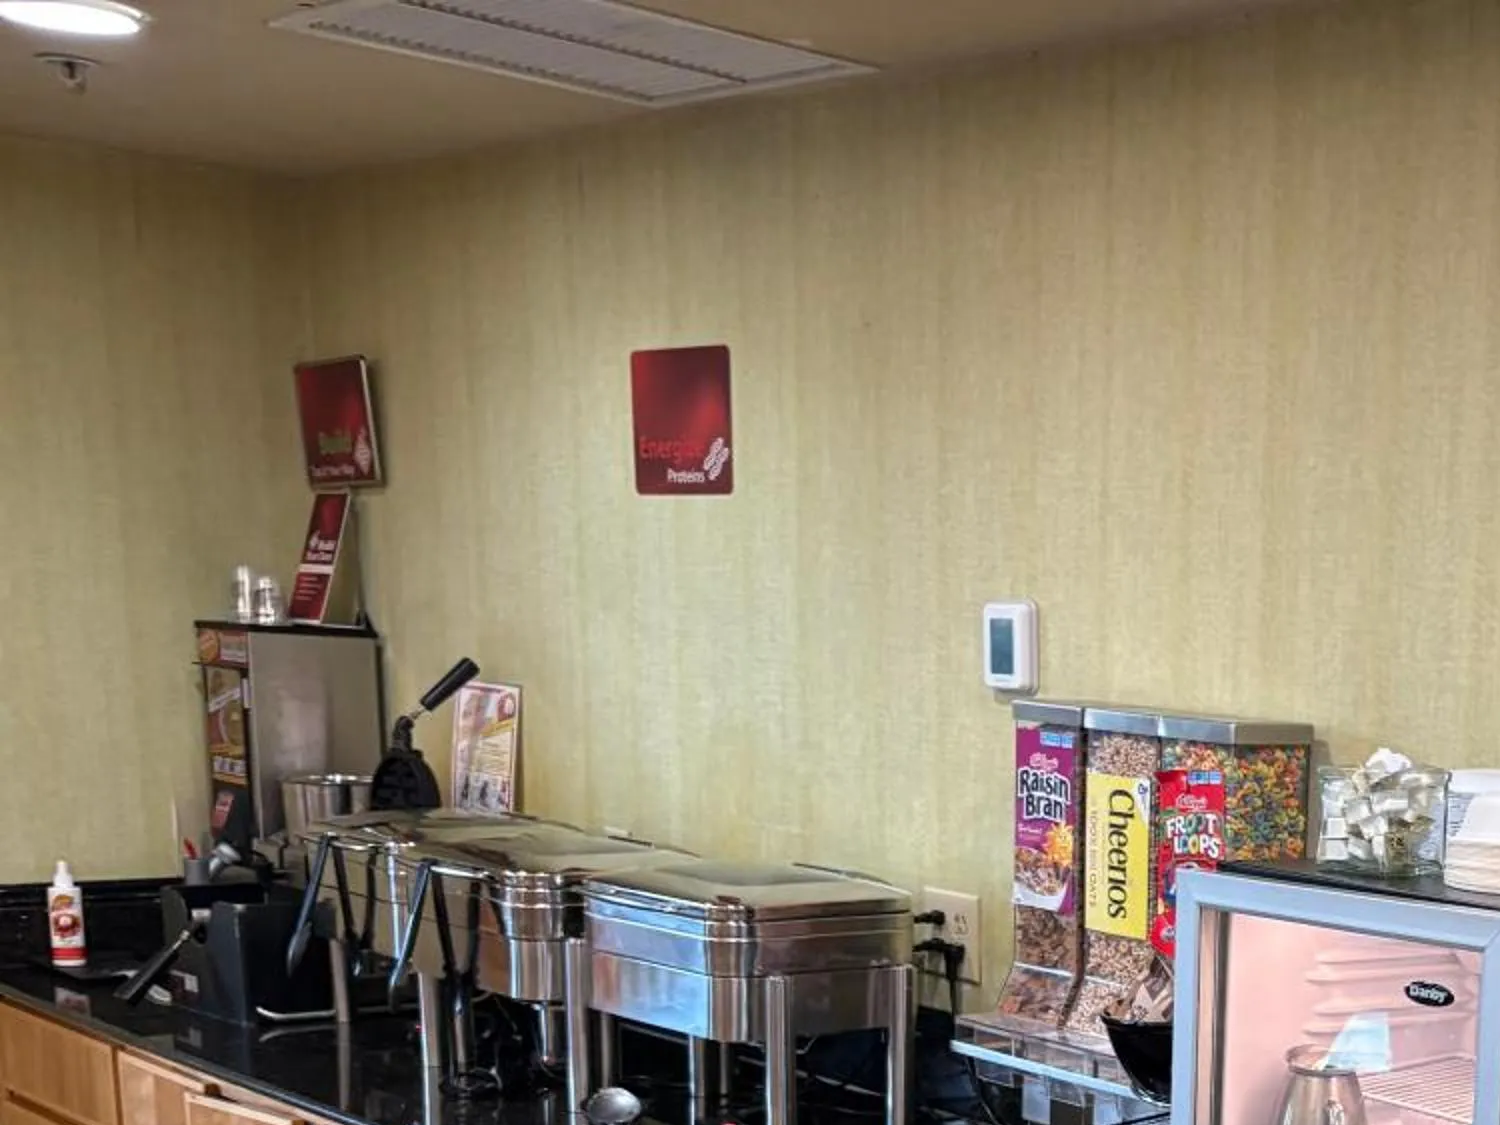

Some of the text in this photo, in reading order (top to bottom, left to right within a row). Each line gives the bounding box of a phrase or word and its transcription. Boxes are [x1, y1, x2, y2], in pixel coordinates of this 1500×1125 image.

[1019, 769, 1070, 802] Raisin
[1025, 794, 1063, 818] Bran
[1106, 789, 1136, 919] Cheerios
[1173, 834, 1220, 859] LOOPS
[1410, 985, 1448, 1003] Danby
